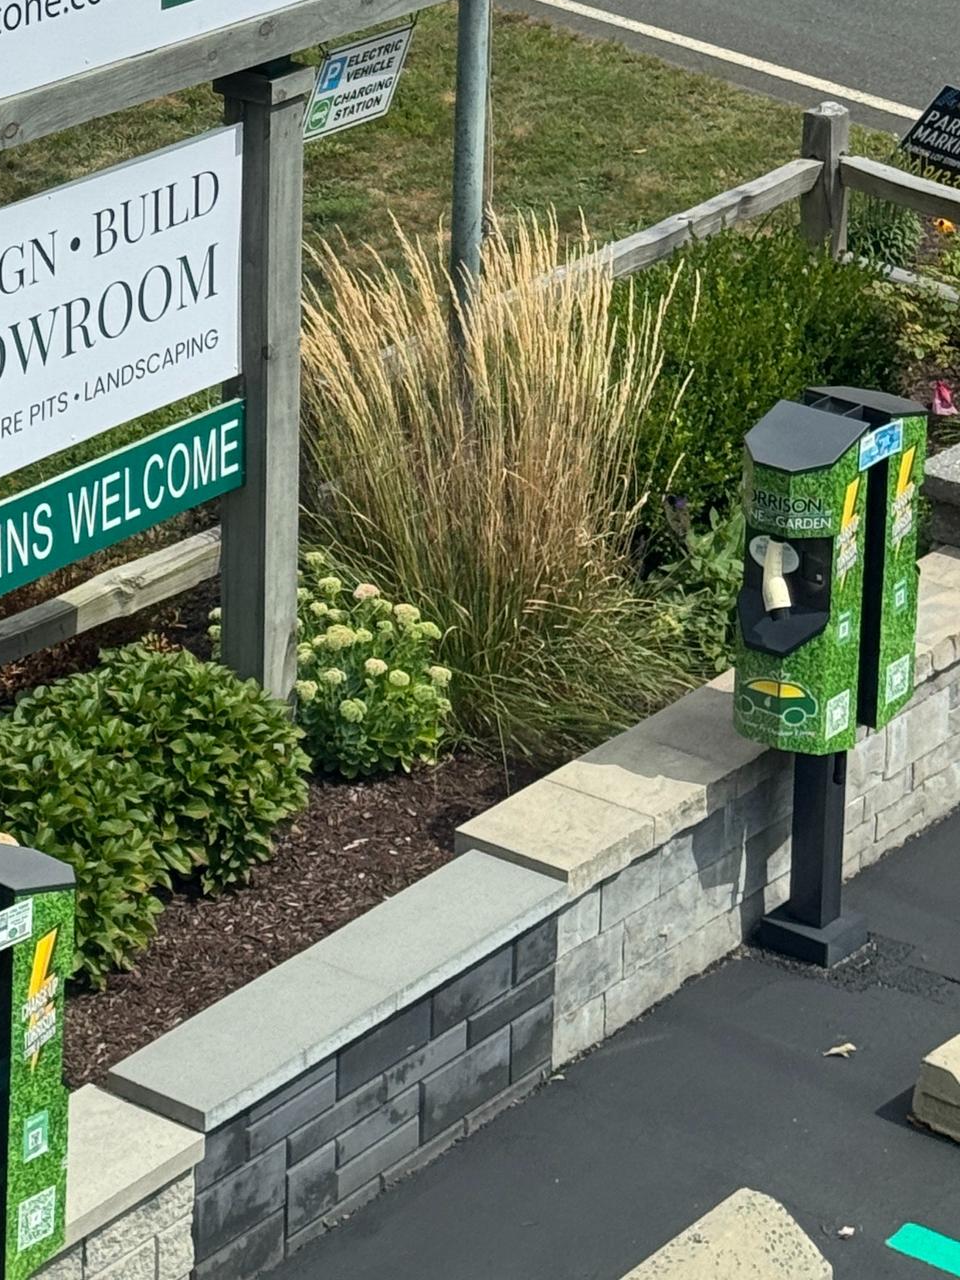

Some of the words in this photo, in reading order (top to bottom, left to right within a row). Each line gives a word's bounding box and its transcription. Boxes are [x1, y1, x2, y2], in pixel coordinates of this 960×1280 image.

[346, 38, 404, 68] ELECTRIC
[346, 56, 395, 83] VEHICLE
[333, 76, 393, 107] CHARGING
[333, 94, 383, 121] STATION
[92, 170, 220, 259] BUILD
[29, 391, 68, 429] PITS
[84, 328, 219, 403] LANDSCAPING
[67, 418, 239, 545] WELCOME
[775, 515, 832, 529] GARDEN
